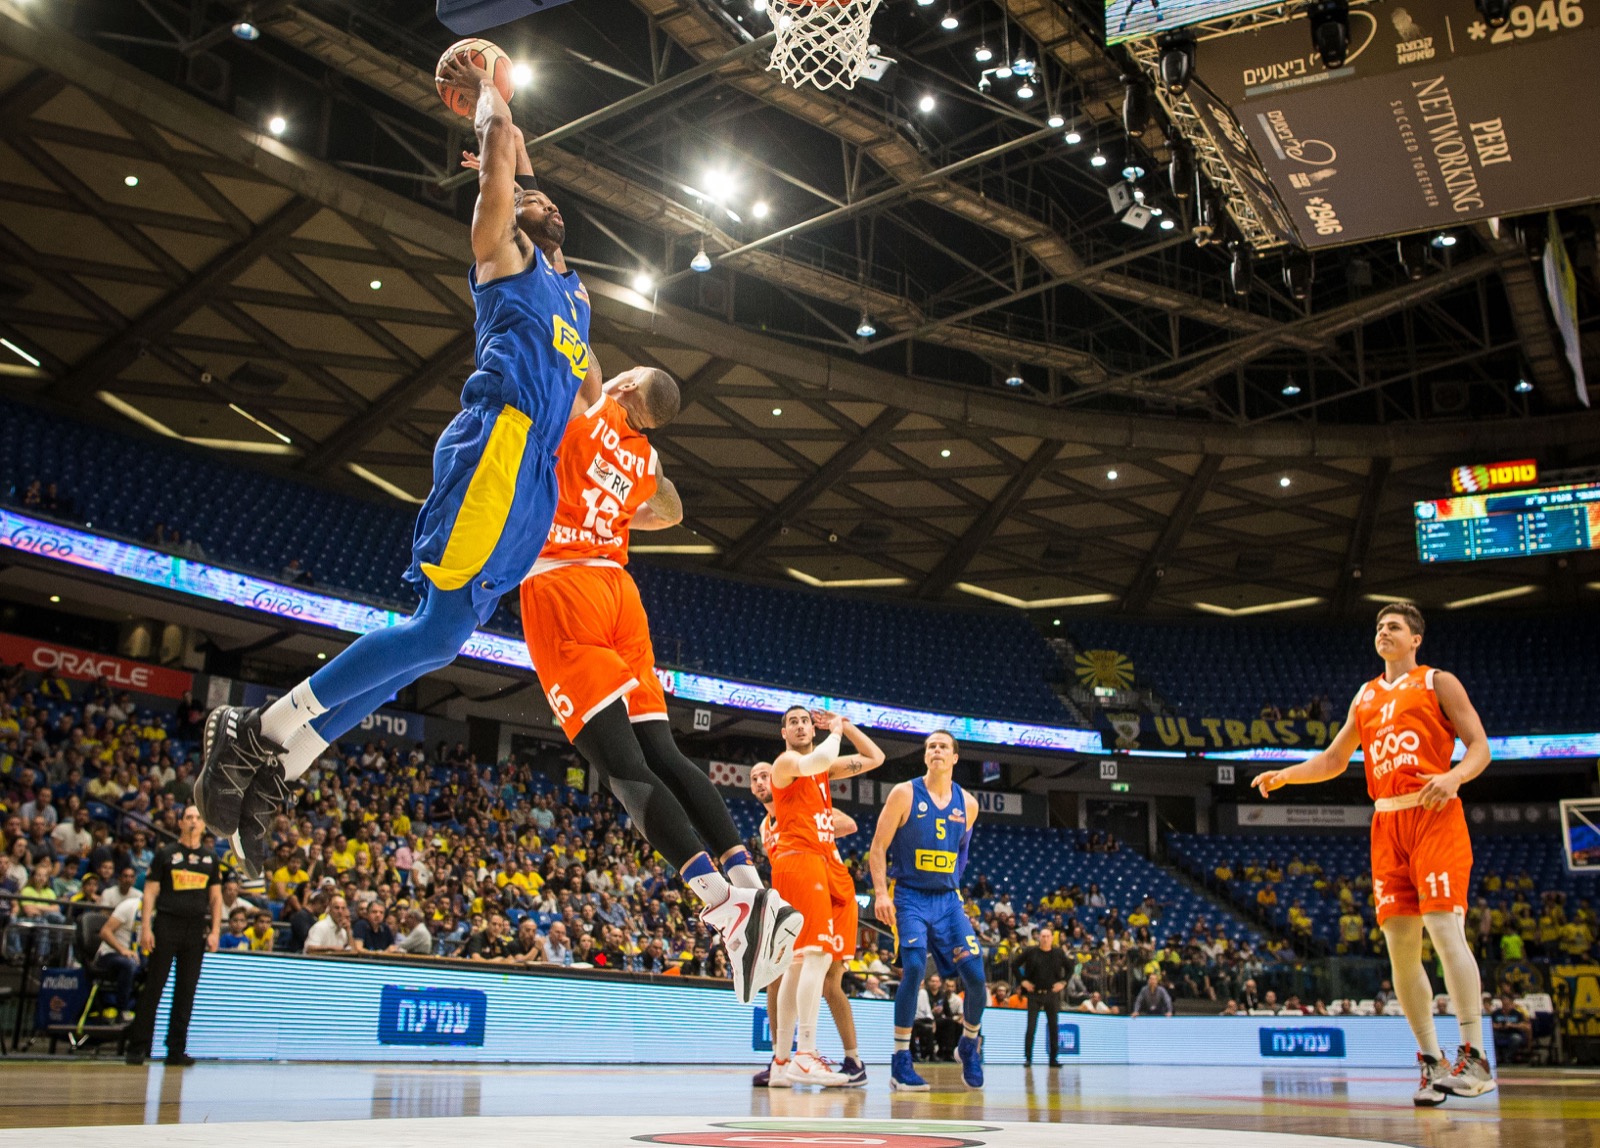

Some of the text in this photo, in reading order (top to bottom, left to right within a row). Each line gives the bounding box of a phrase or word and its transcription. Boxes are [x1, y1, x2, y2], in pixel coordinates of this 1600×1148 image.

[1243, 58, 1307, 86] ביצועים
[1390, 100, 1439, 207] SUCCEED TOGETHER
[1411, 75, 1484, 213] NETWORKING
[1470, 117, 1512, 167] PERI
[1489, 464, 1536, 484] טוטו
[32, 647, 149, 688] ORACLE
[695, 712, 710, 727] 10
[1380, 699, 1396, 724] 11
[1154, 716, 1301, 748] ULTRAS
[1102, 764, 1116, 776] 10
[1220, 769, 1232, 781] 11
[935, 818, 946, 840] 5
[1425, 871, 1451, 898] 11
[965, 934, 980, 955] 5
[396, 999, 471, 1034] עמינח
[1272, 1032, 1330, 1052] עמינח
